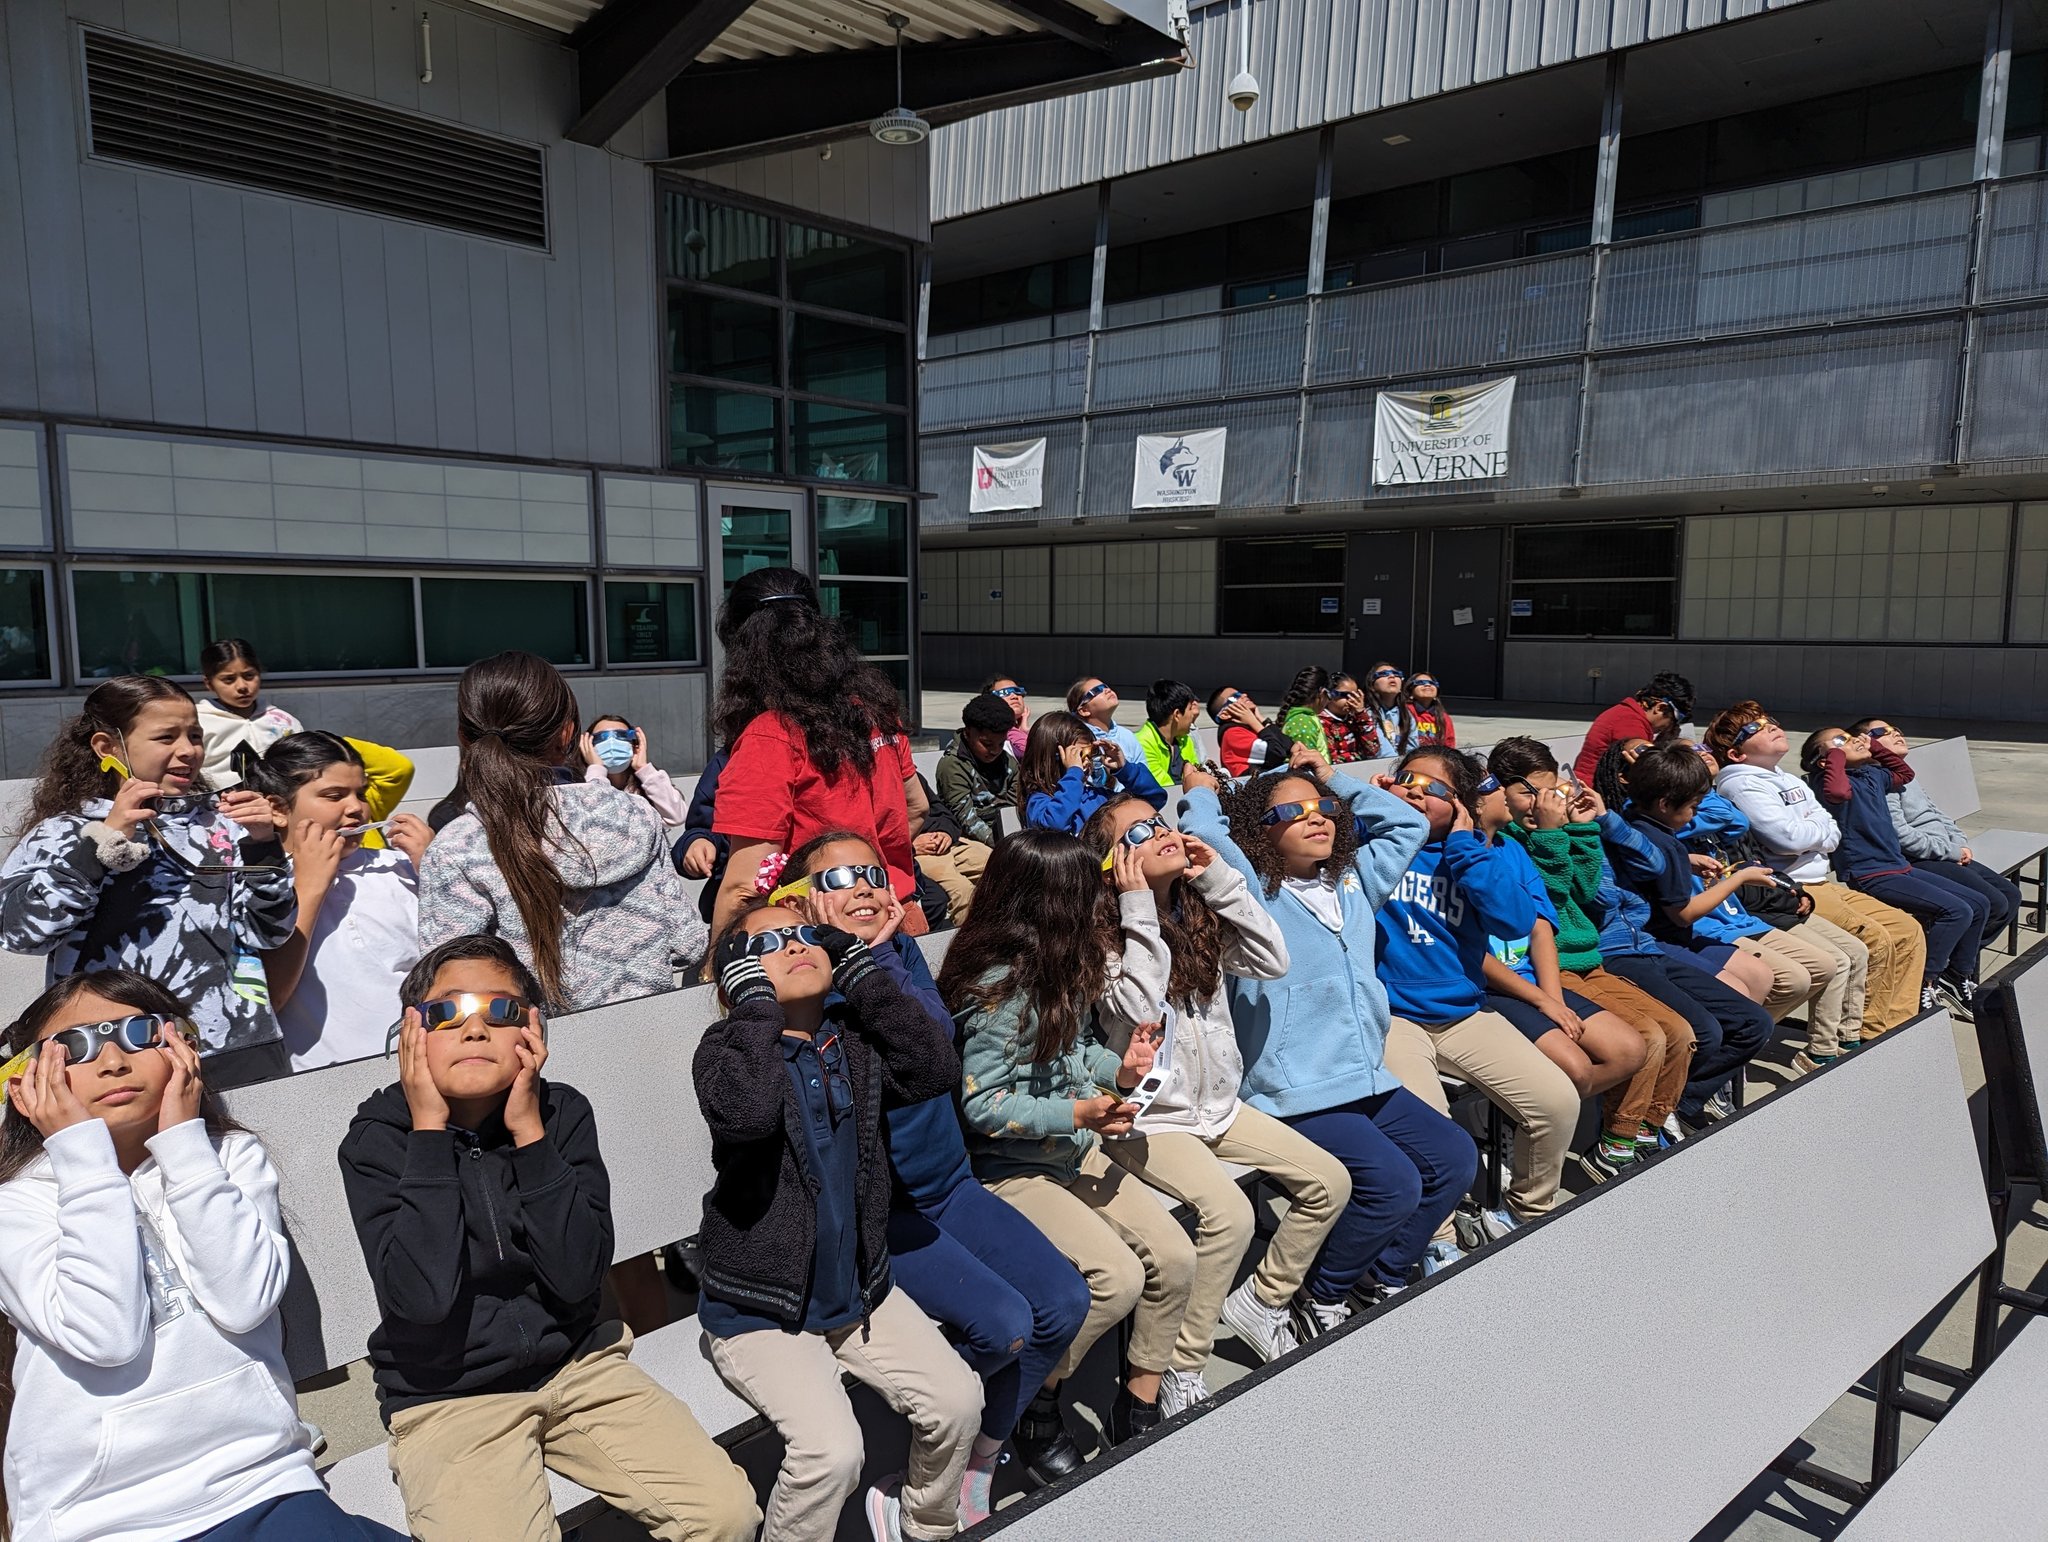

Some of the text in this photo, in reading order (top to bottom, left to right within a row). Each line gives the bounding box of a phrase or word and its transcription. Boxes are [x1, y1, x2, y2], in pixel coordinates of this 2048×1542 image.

[1390, 433, 1492, 453] UNIVERSITY OF
[994, 467, 1041, 479] UNIVERSITY
[1372, 450, 1508, 485] LA VERNE
[1007, 478, 1028, 488] UTAH
[1176, 469, 1197, 487] W
[1156, 488, 1197, 496] WASHINGTON
